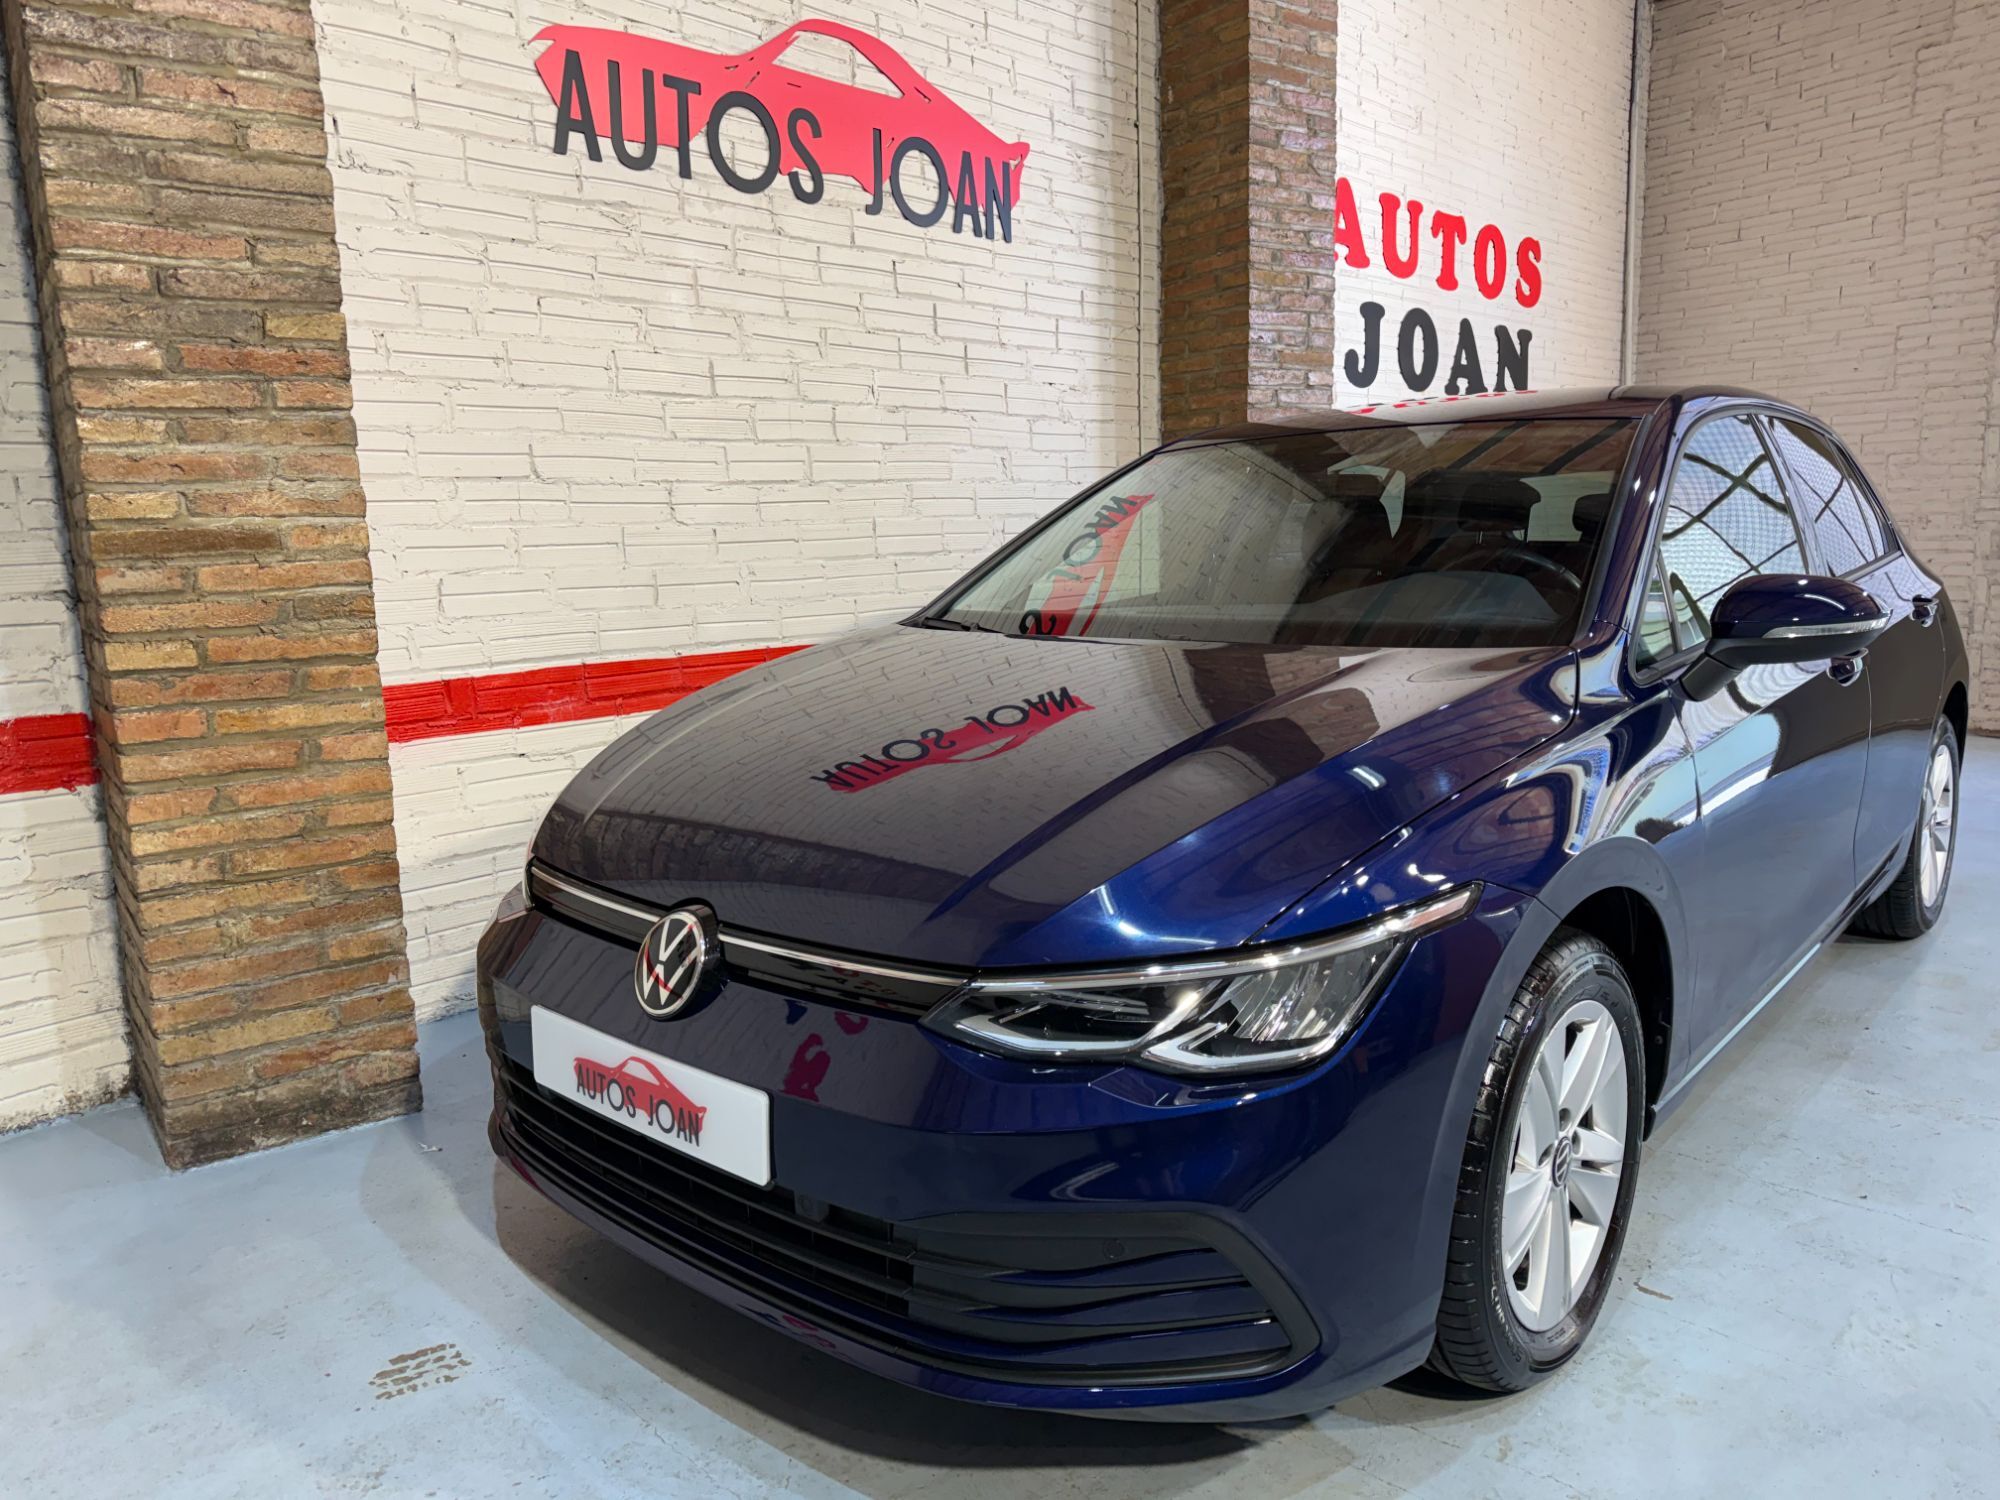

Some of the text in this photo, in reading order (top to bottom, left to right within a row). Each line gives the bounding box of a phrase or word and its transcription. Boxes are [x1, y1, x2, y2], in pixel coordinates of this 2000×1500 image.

[553, 48, 1012, 243] AUTOS JOAN
[1334, 177, 1542, 308] AUTOS
[1344, 301, 1533, 396] JOAN
[576, 1063, 700, 1147] AUTOS JOAN
